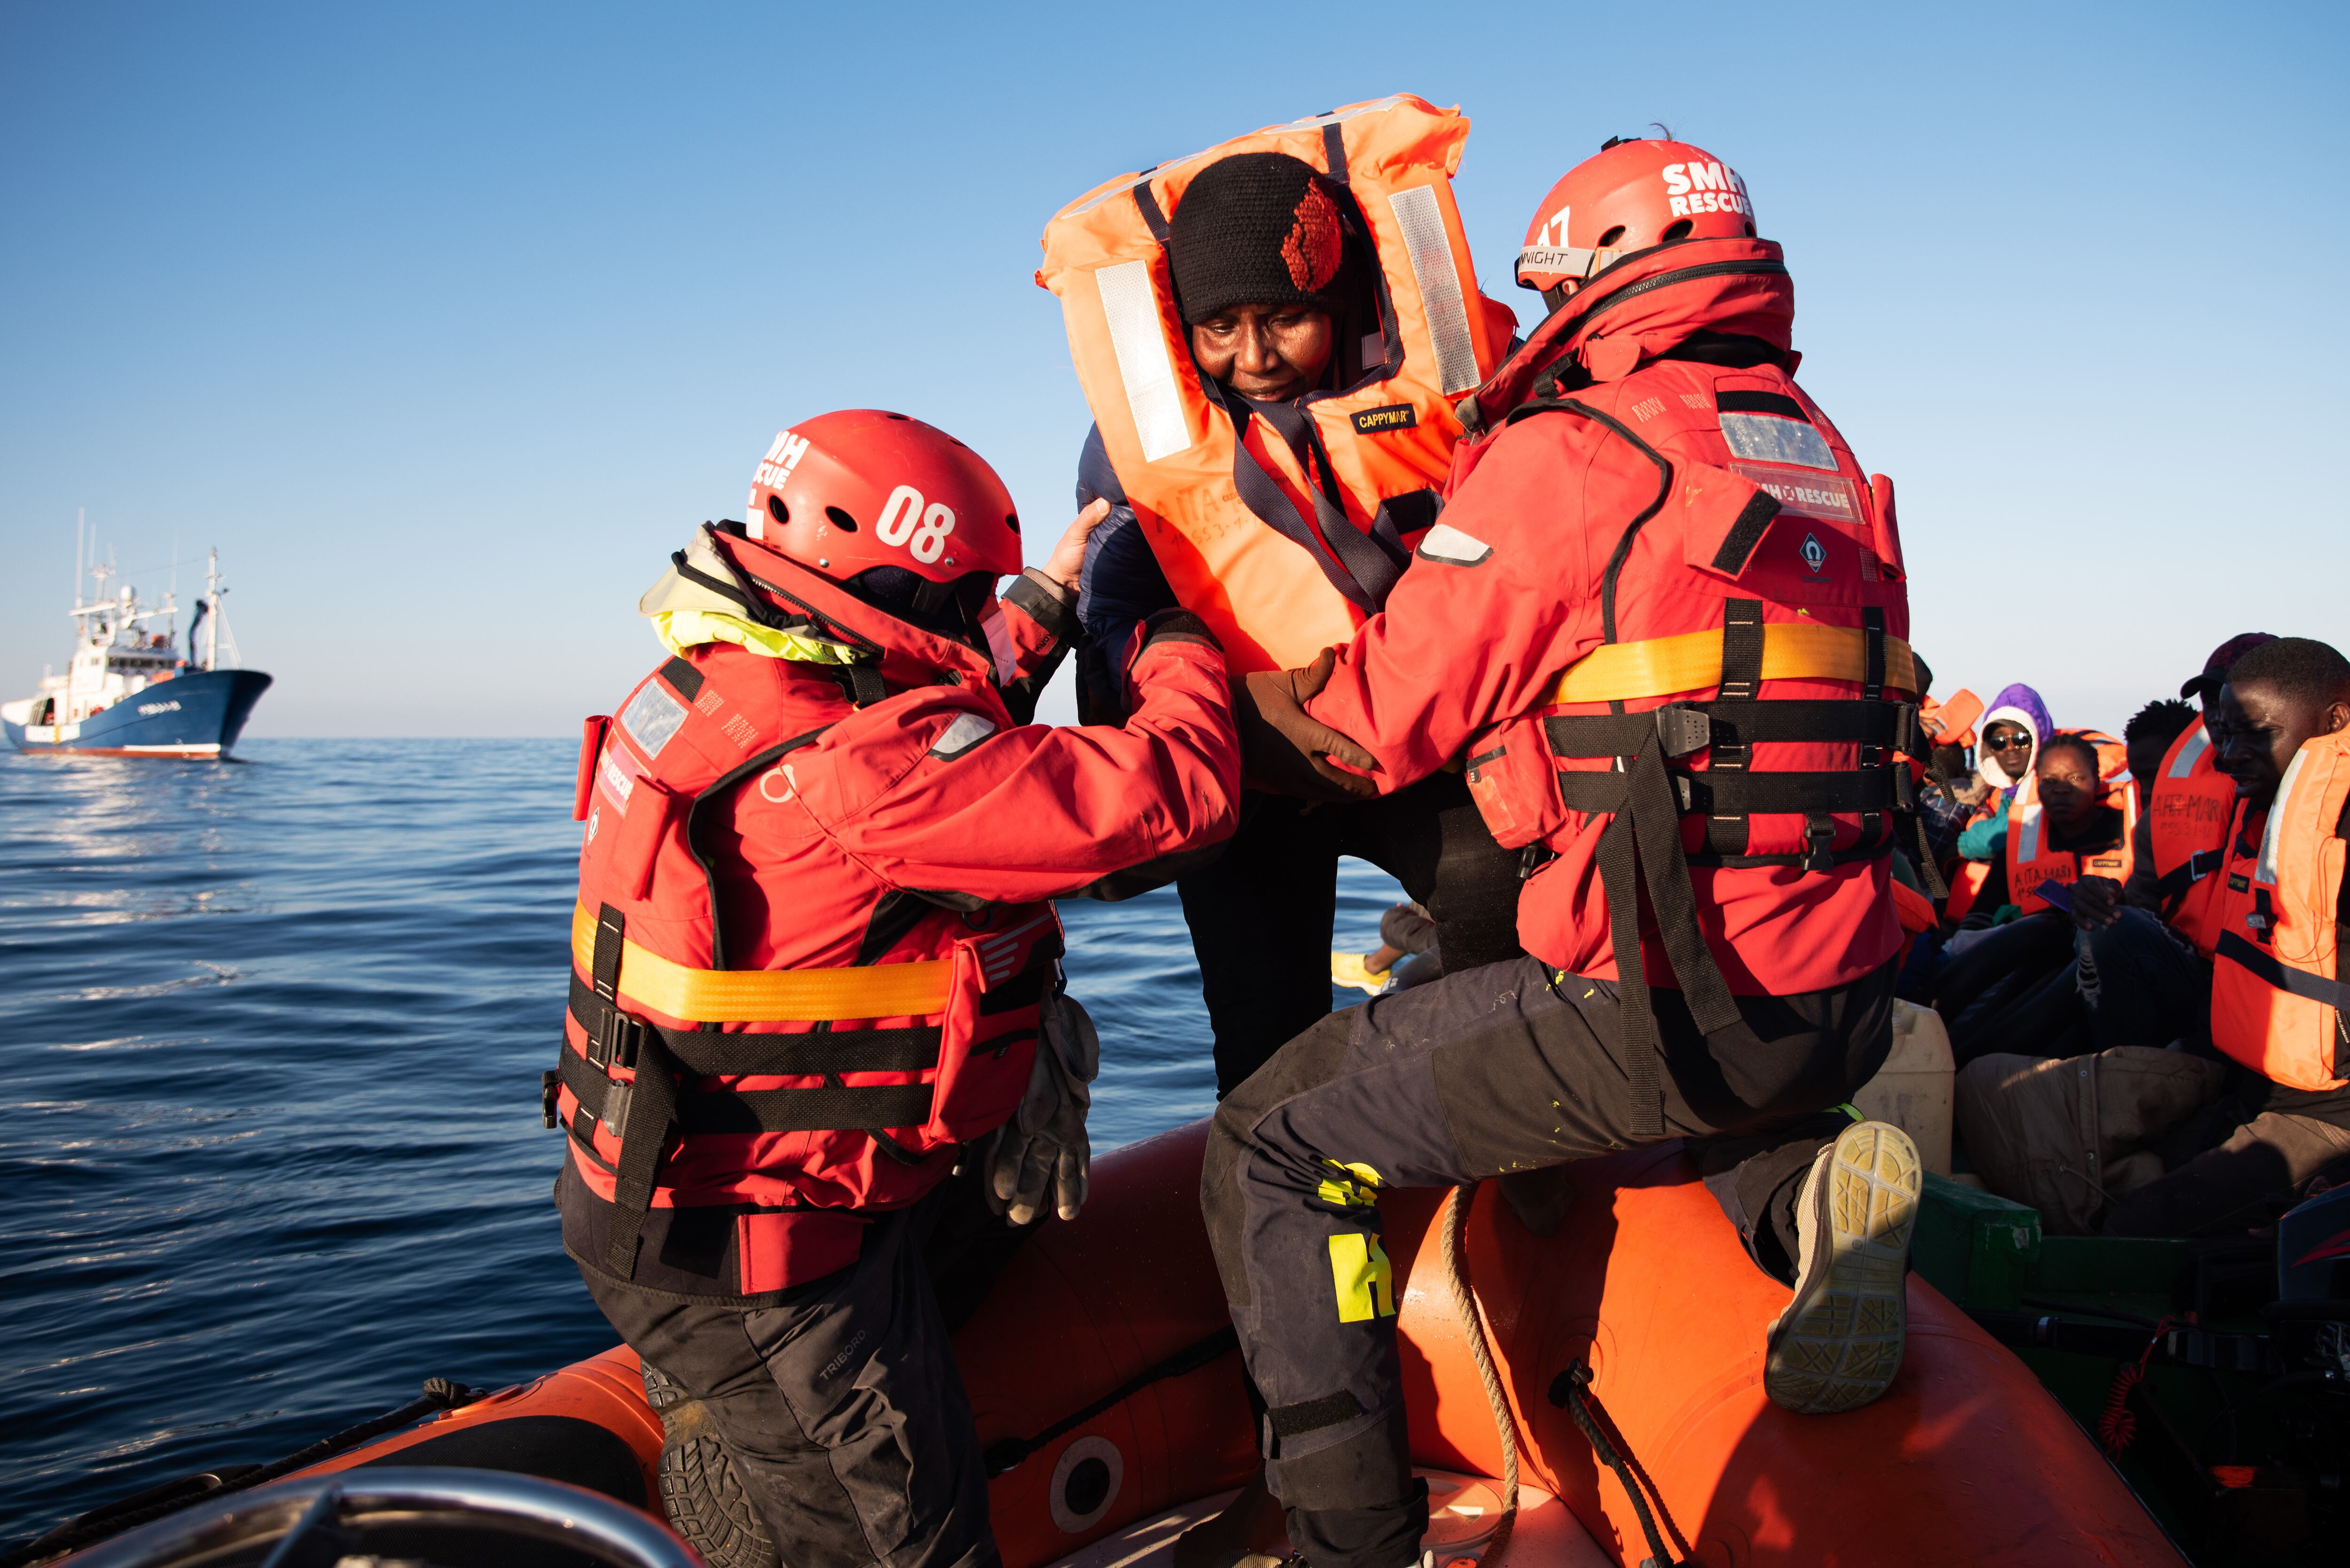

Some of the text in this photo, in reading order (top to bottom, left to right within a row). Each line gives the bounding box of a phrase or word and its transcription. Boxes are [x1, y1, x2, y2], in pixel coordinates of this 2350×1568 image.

[1669, 192, 1752, 218] RESCUE
[1794, 486, 1850, 509] RESCUE
[876, 485, 956, 564] 08
[819, 1330, 866, 1380] TRIBORD
